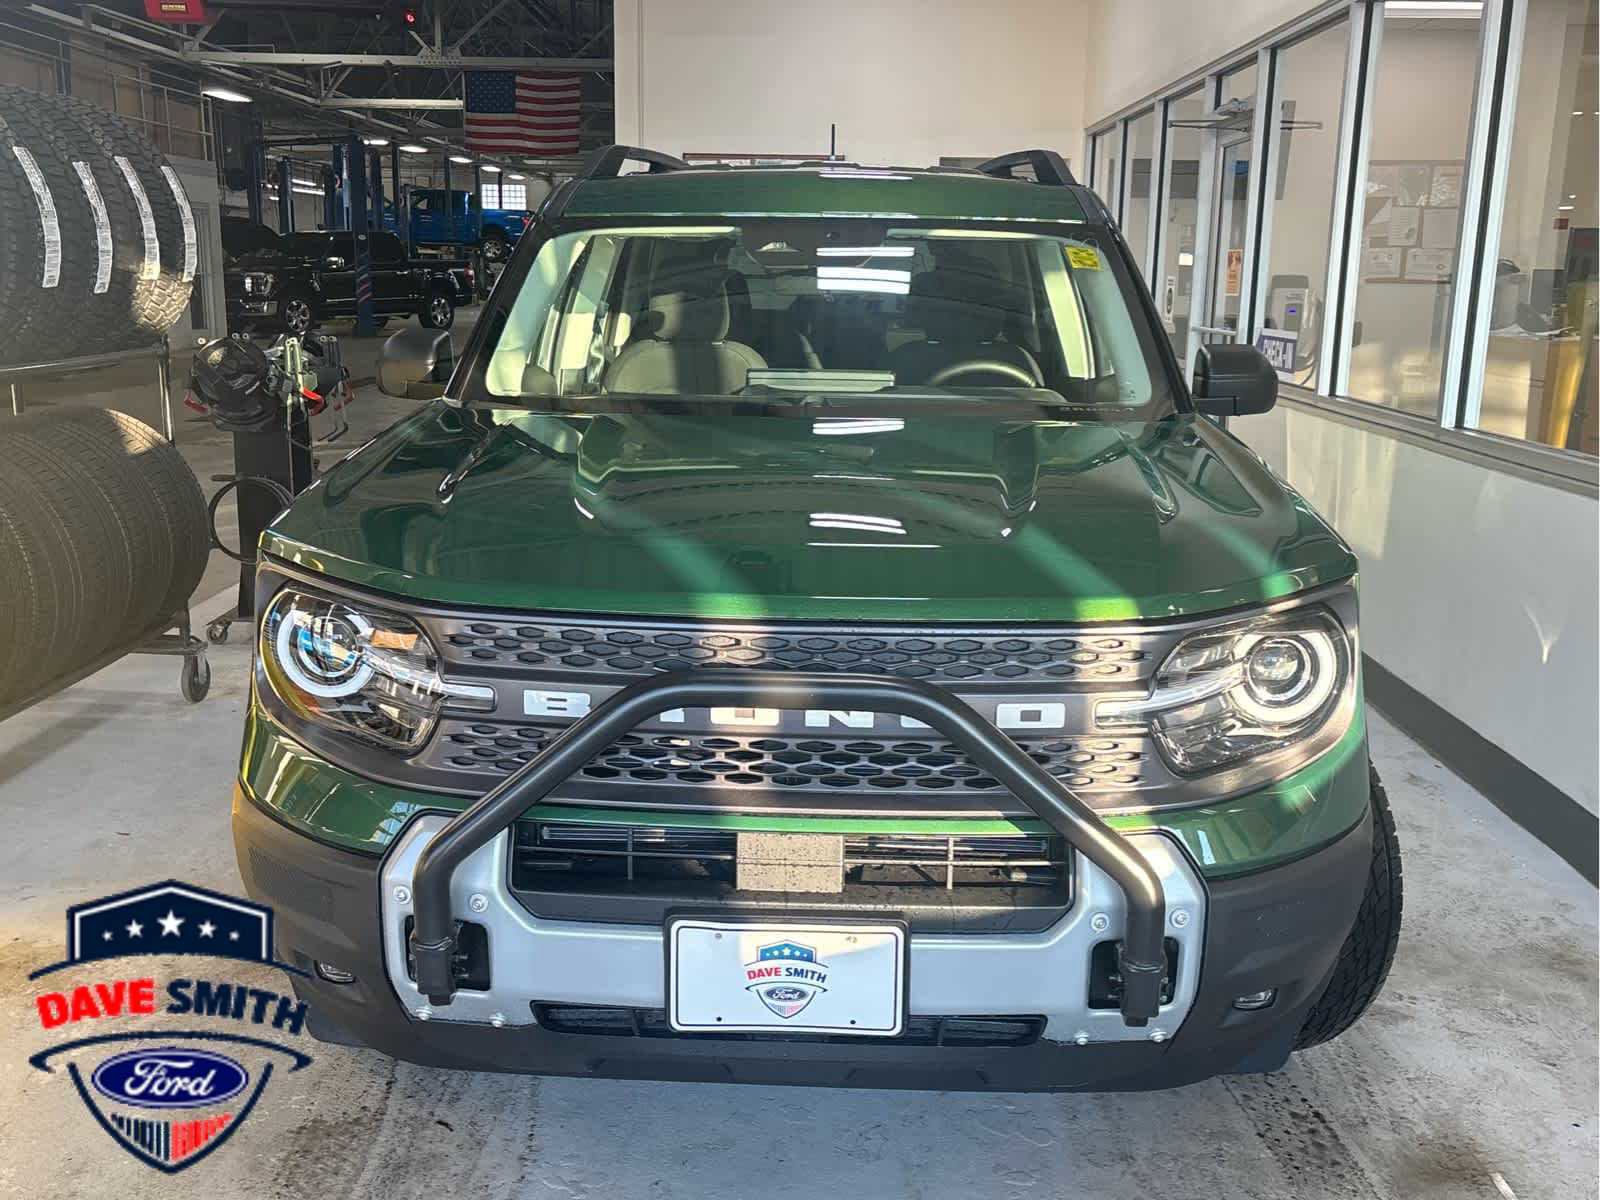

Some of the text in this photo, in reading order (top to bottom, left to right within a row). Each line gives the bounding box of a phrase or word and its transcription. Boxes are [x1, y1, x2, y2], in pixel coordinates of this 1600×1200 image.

[523, 690, 1066, 729] BONO
[747, 967, 827, 983] DAVE SMITH
[772, 988, 801, 1000] Ford
